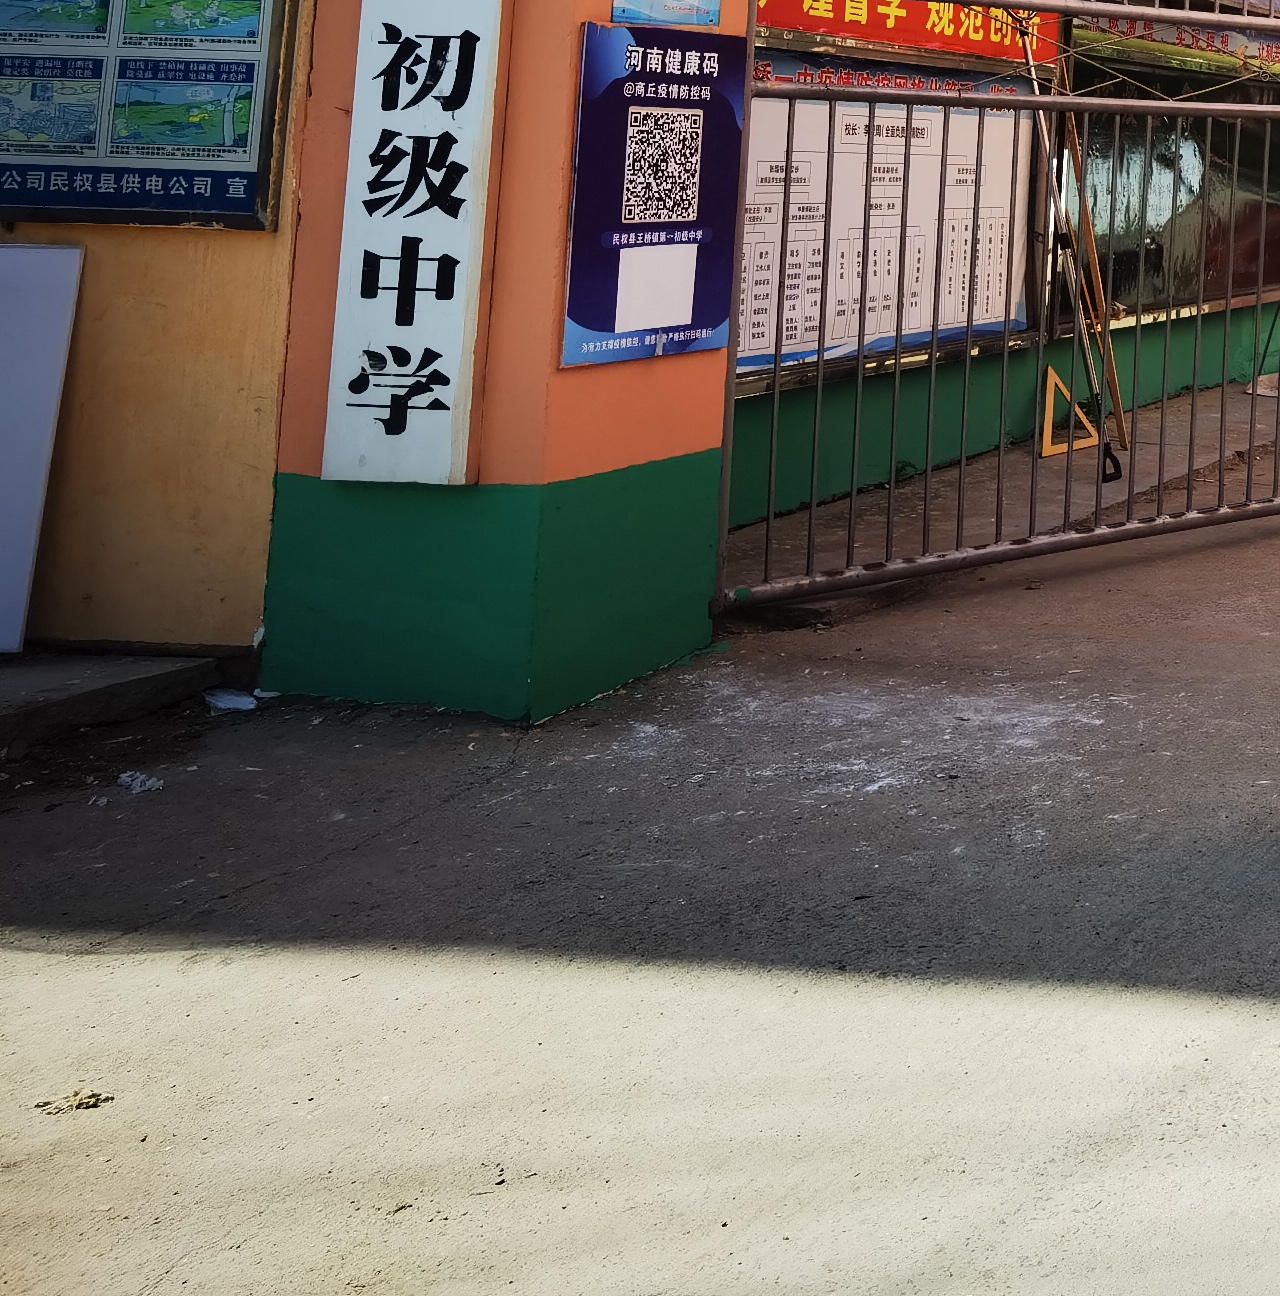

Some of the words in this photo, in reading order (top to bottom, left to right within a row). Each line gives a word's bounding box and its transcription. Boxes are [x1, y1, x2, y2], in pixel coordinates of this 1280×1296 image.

[624, 45, 719, 77] 河南健康码
[623, 82, 712, 101] @商丘疫情防控码
[1, 171, 213, 197] 公司民权县供电公司
[226, 177, 248, 198] 宣
